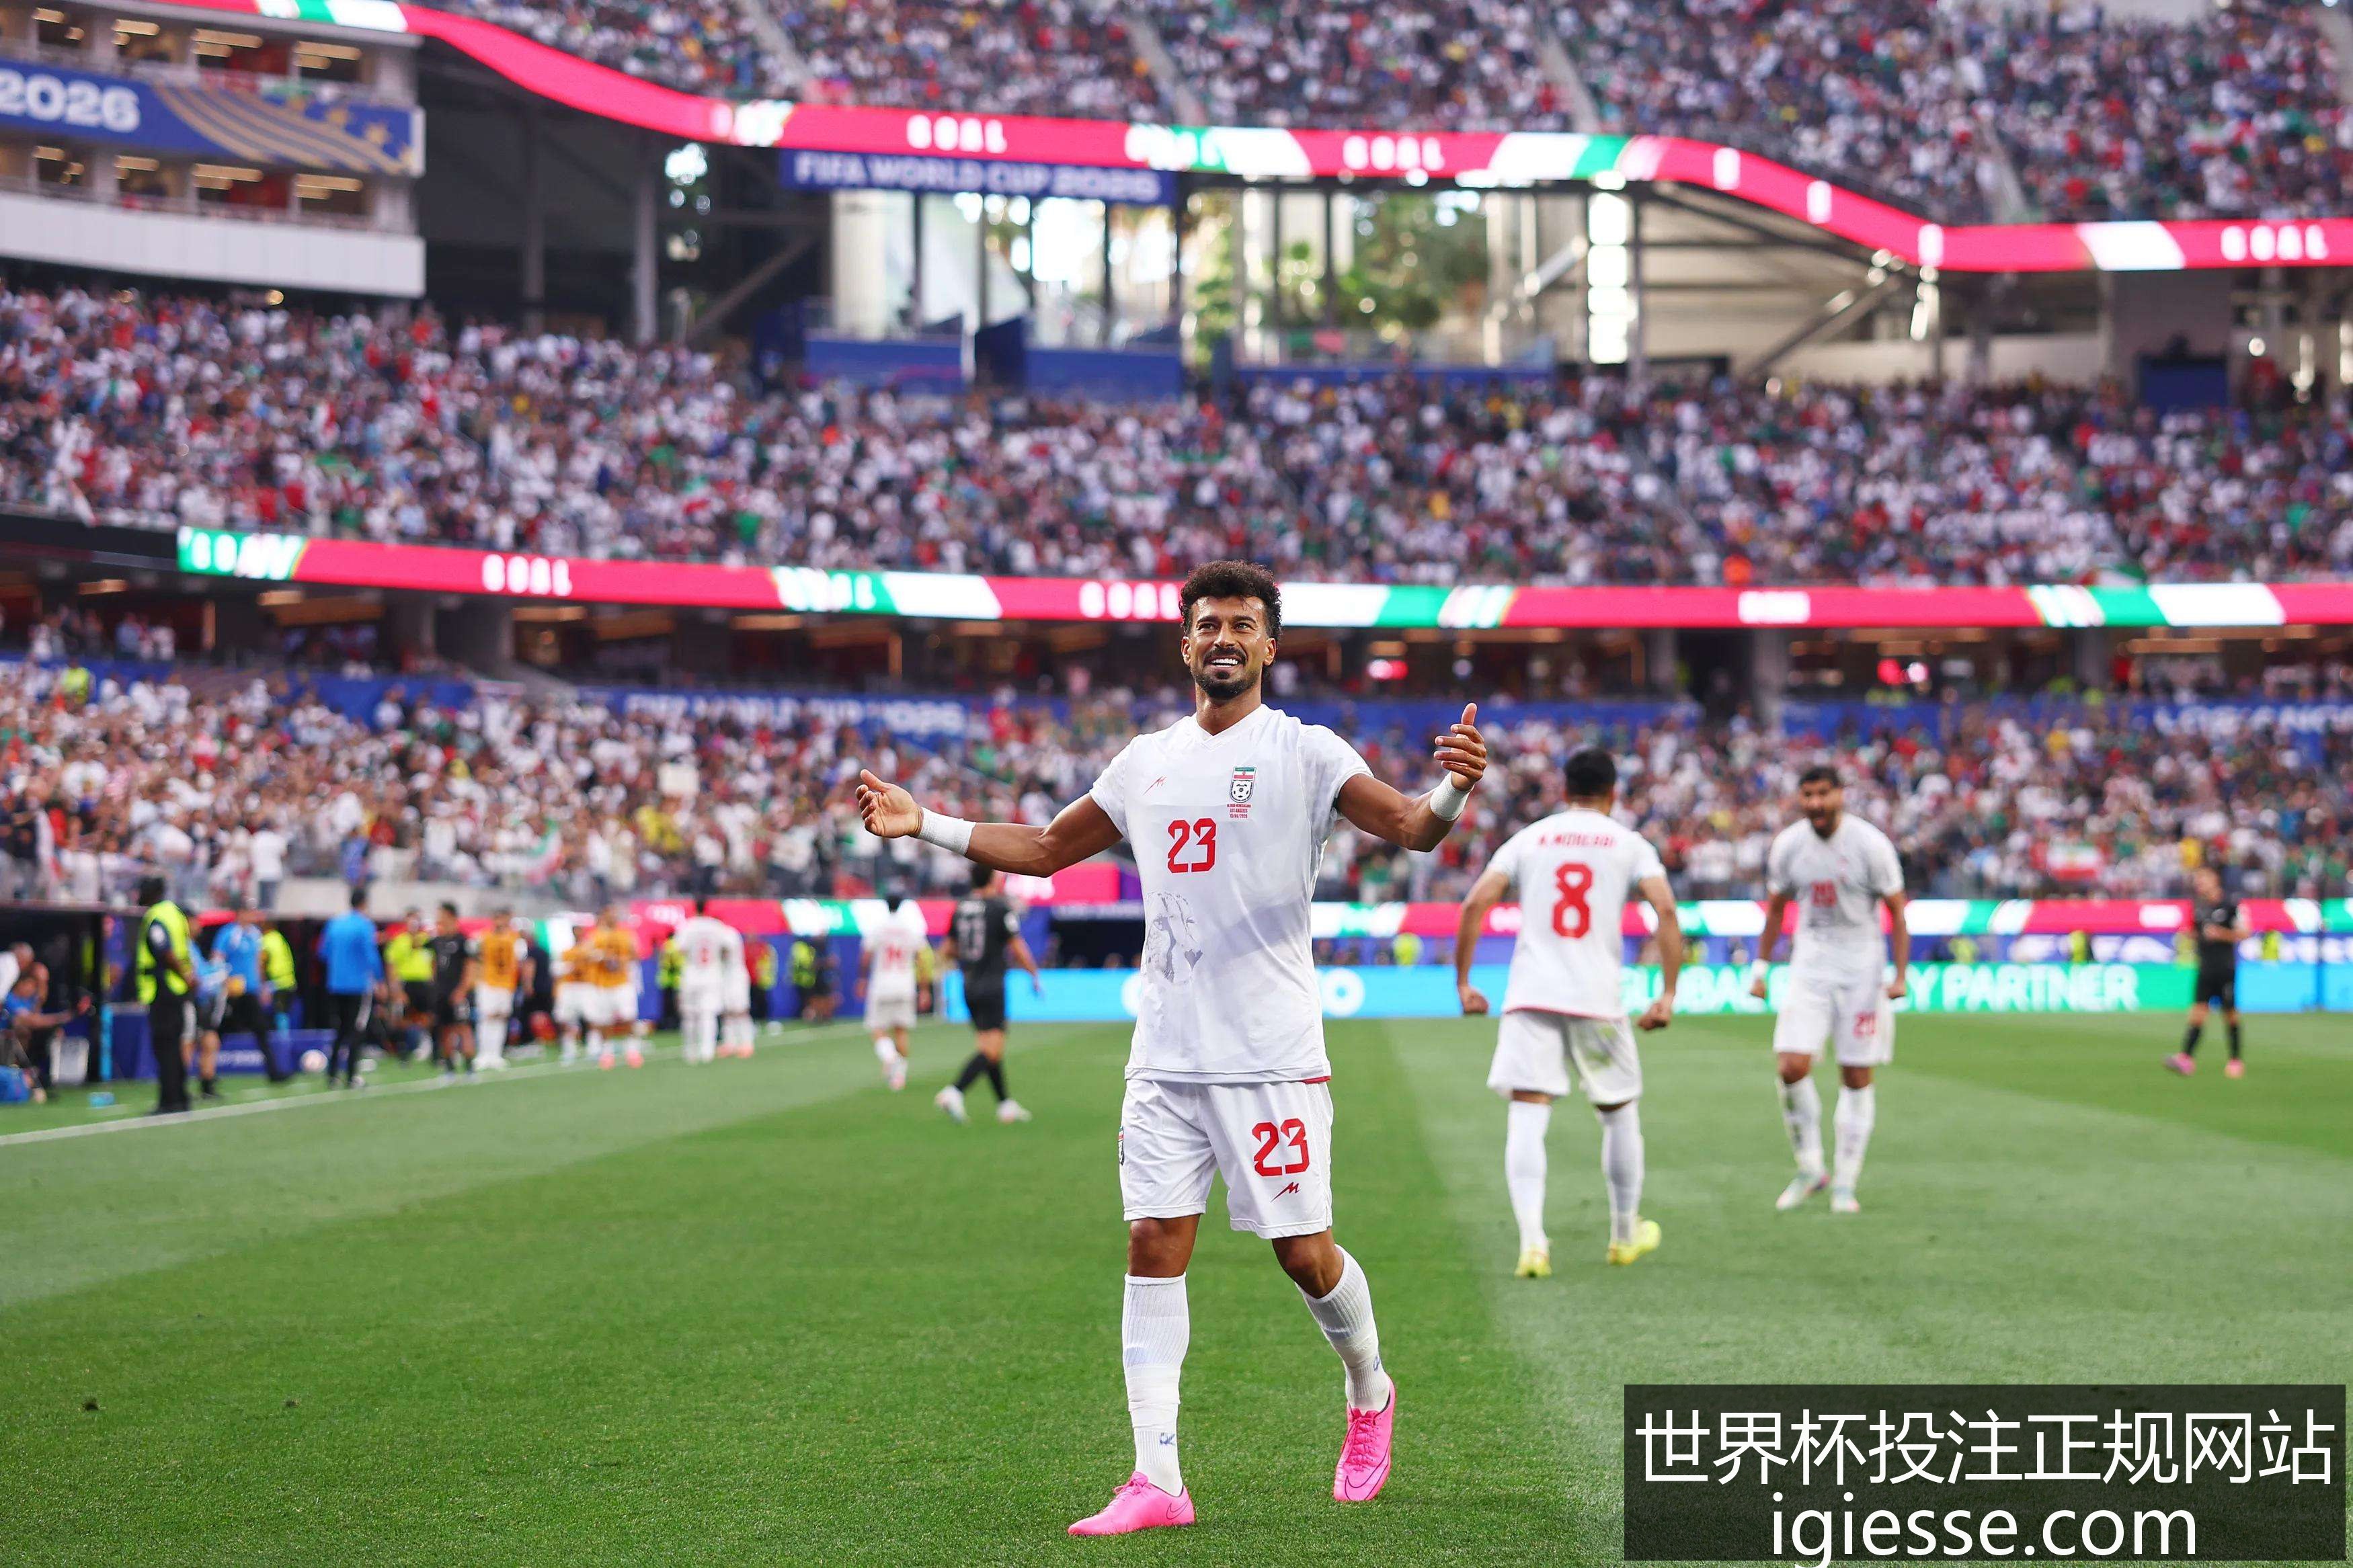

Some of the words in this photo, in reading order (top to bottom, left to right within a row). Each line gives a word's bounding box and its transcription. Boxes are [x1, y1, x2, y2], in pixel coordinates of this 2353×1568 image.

[0, 69, 141, 132] 2026
[871, 155, 984, 192] WORLD
[987, 160, 1049, 195] CUP
[1167, 817, 1217, 873] 23
[1552, 862, 1593, 940] 8
[1942, 965, 2139, 1011] PARTNER
[1252, 1118, 1310, 1177] 23
